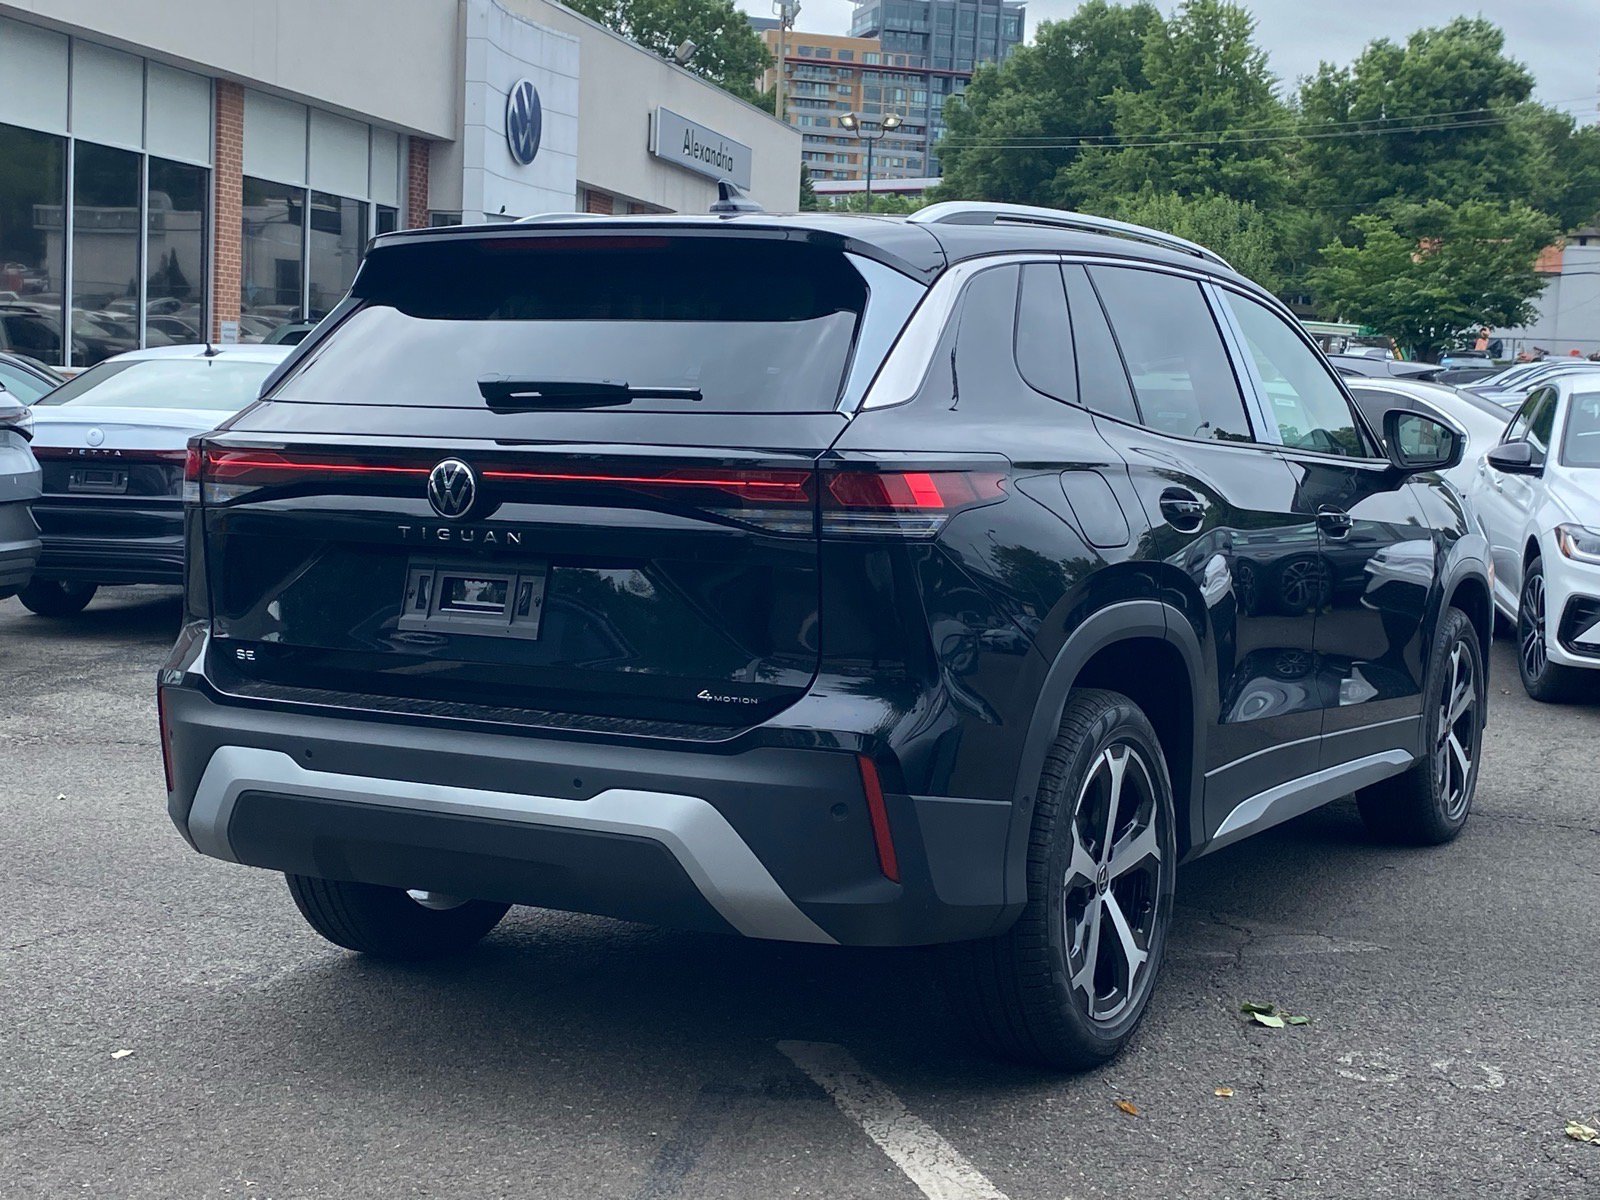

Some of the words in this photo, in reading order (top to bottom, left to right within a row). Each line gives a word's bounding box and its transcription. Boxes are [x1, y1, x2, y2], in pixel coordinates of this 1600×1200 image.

[682, 128, 733, 172] Alexandria
[67, 448, 122, 456] JETTA
[397, 525, 521, 545] TIGUAN
[236, 648, 256, 661] SE
[697, 689, 759, 705] 4MOTION
